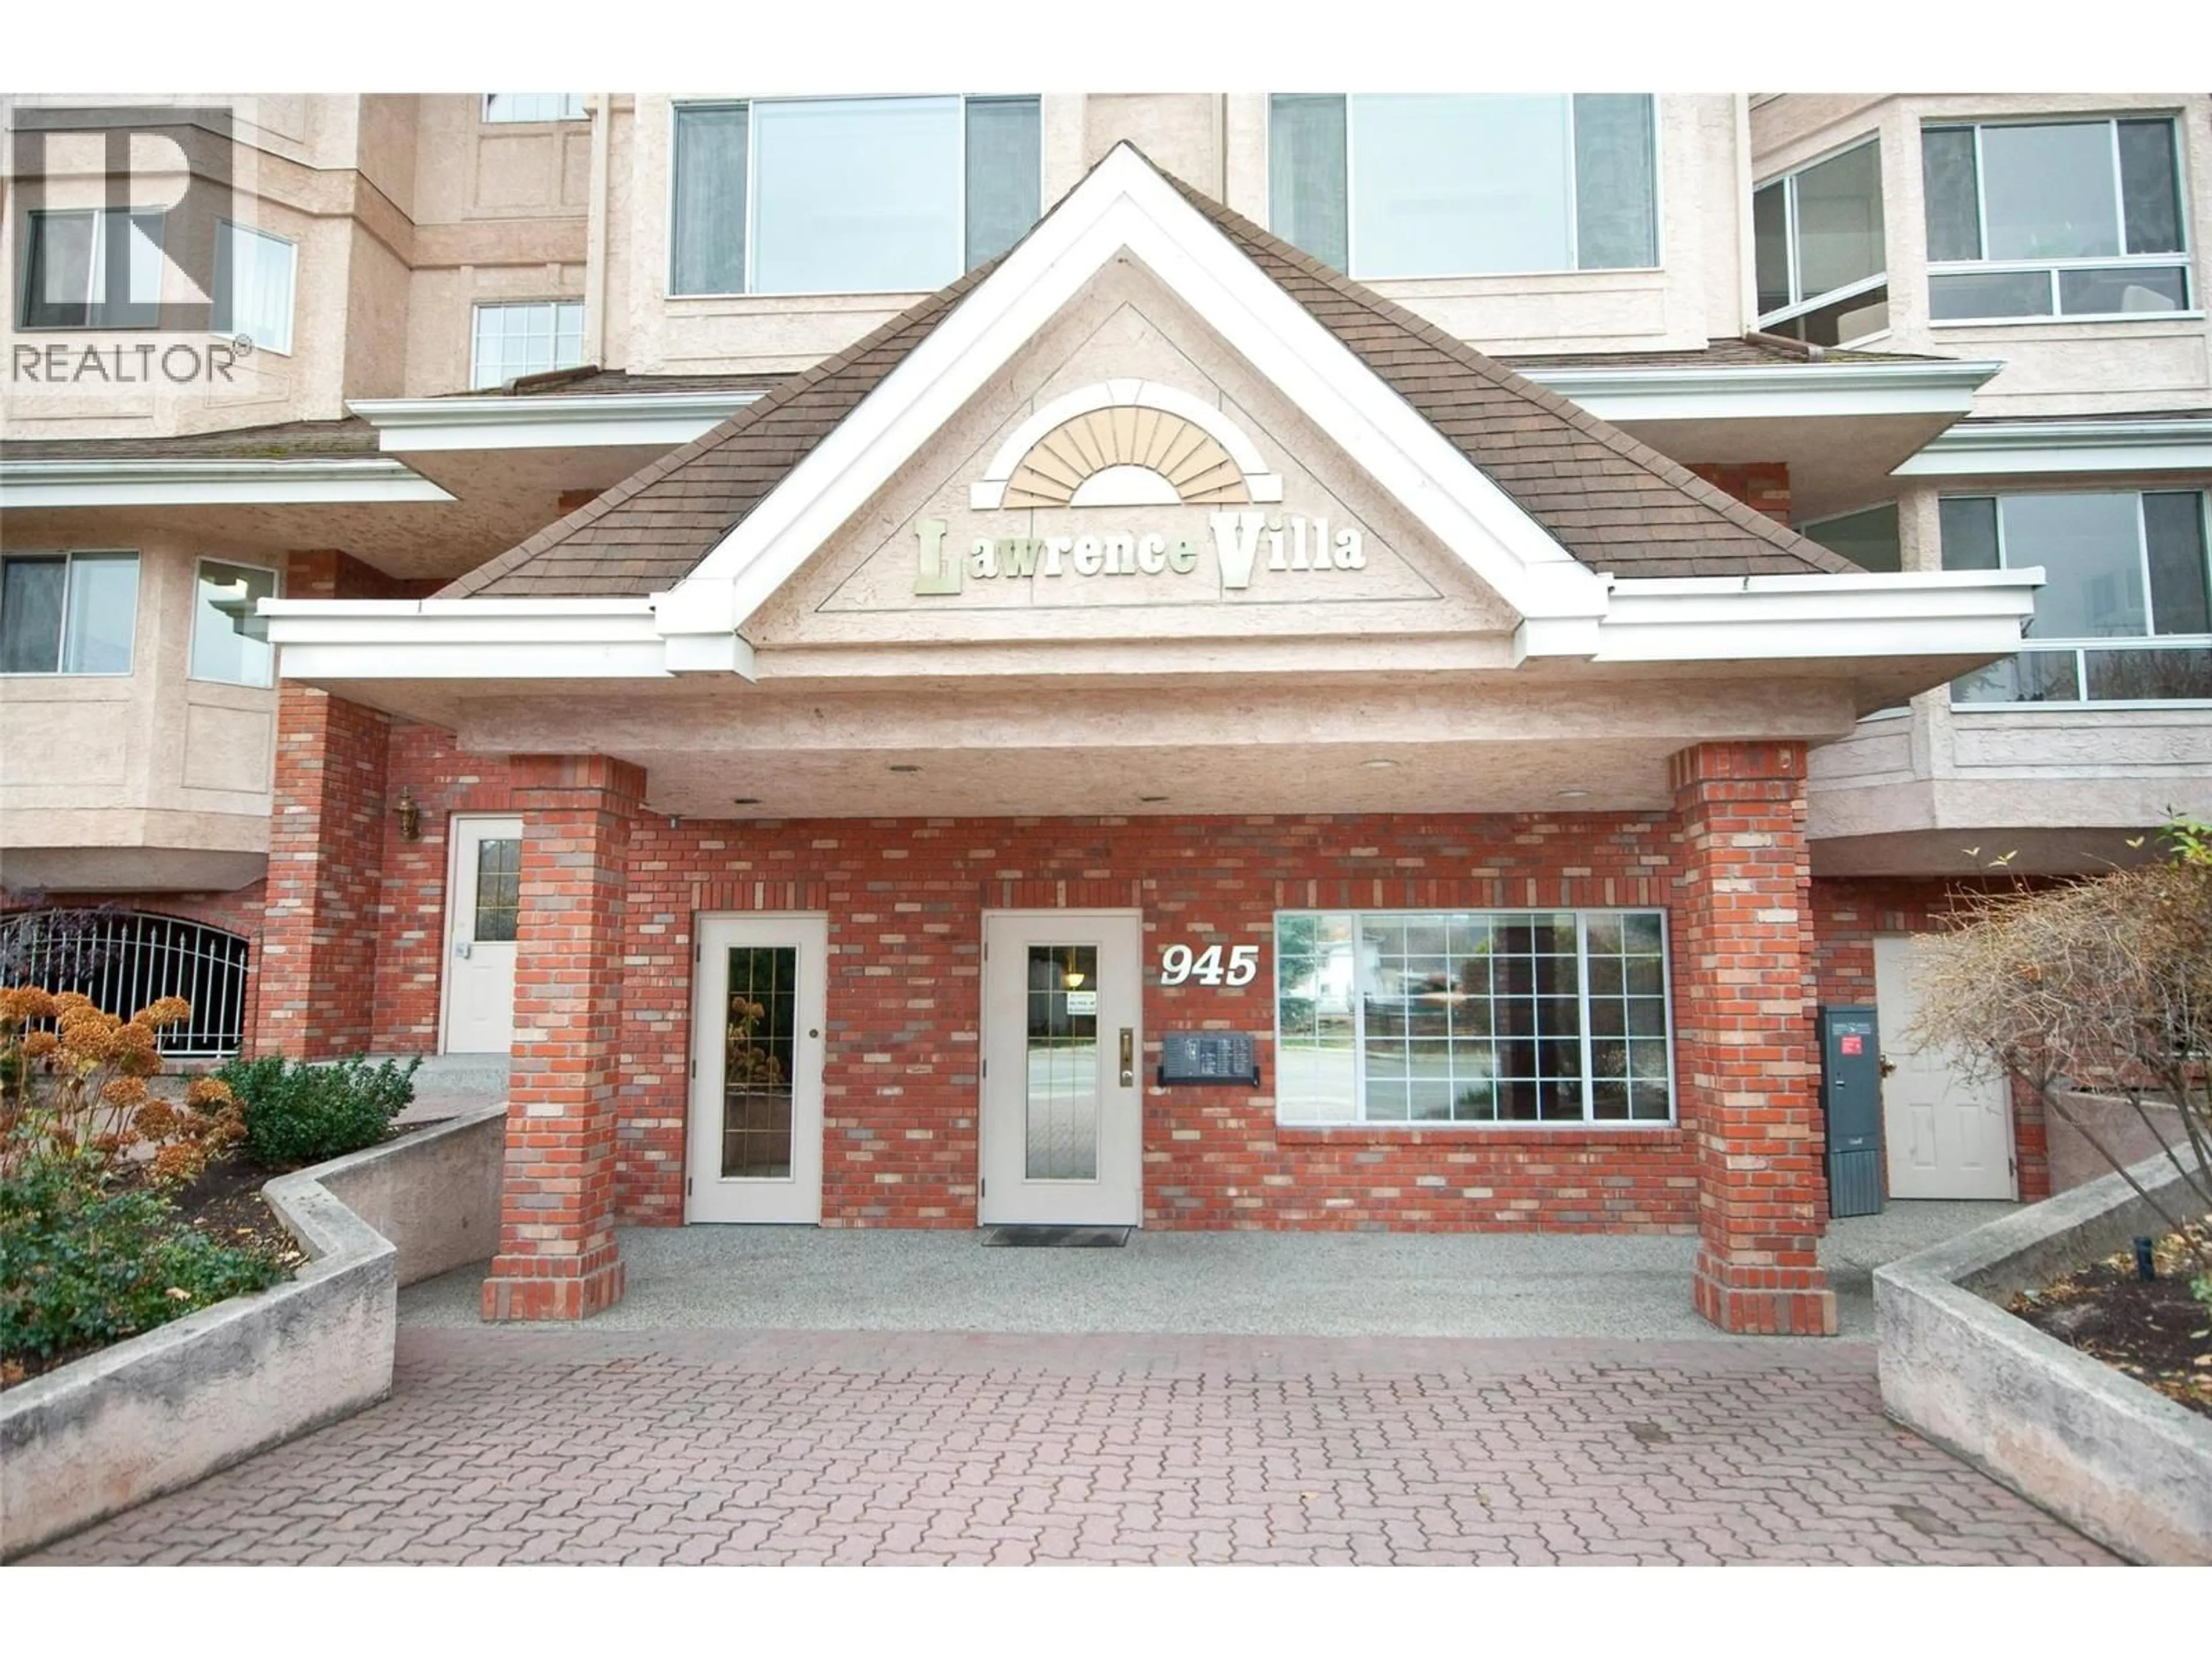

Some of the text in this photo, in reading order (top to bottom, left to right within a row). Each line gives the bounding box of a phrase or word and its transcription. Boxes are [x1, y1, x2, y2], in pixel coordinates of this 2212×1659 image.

[914, 512, 1366, 596] Lawrence Villa
[1160, 944, 1260, 986] 945
